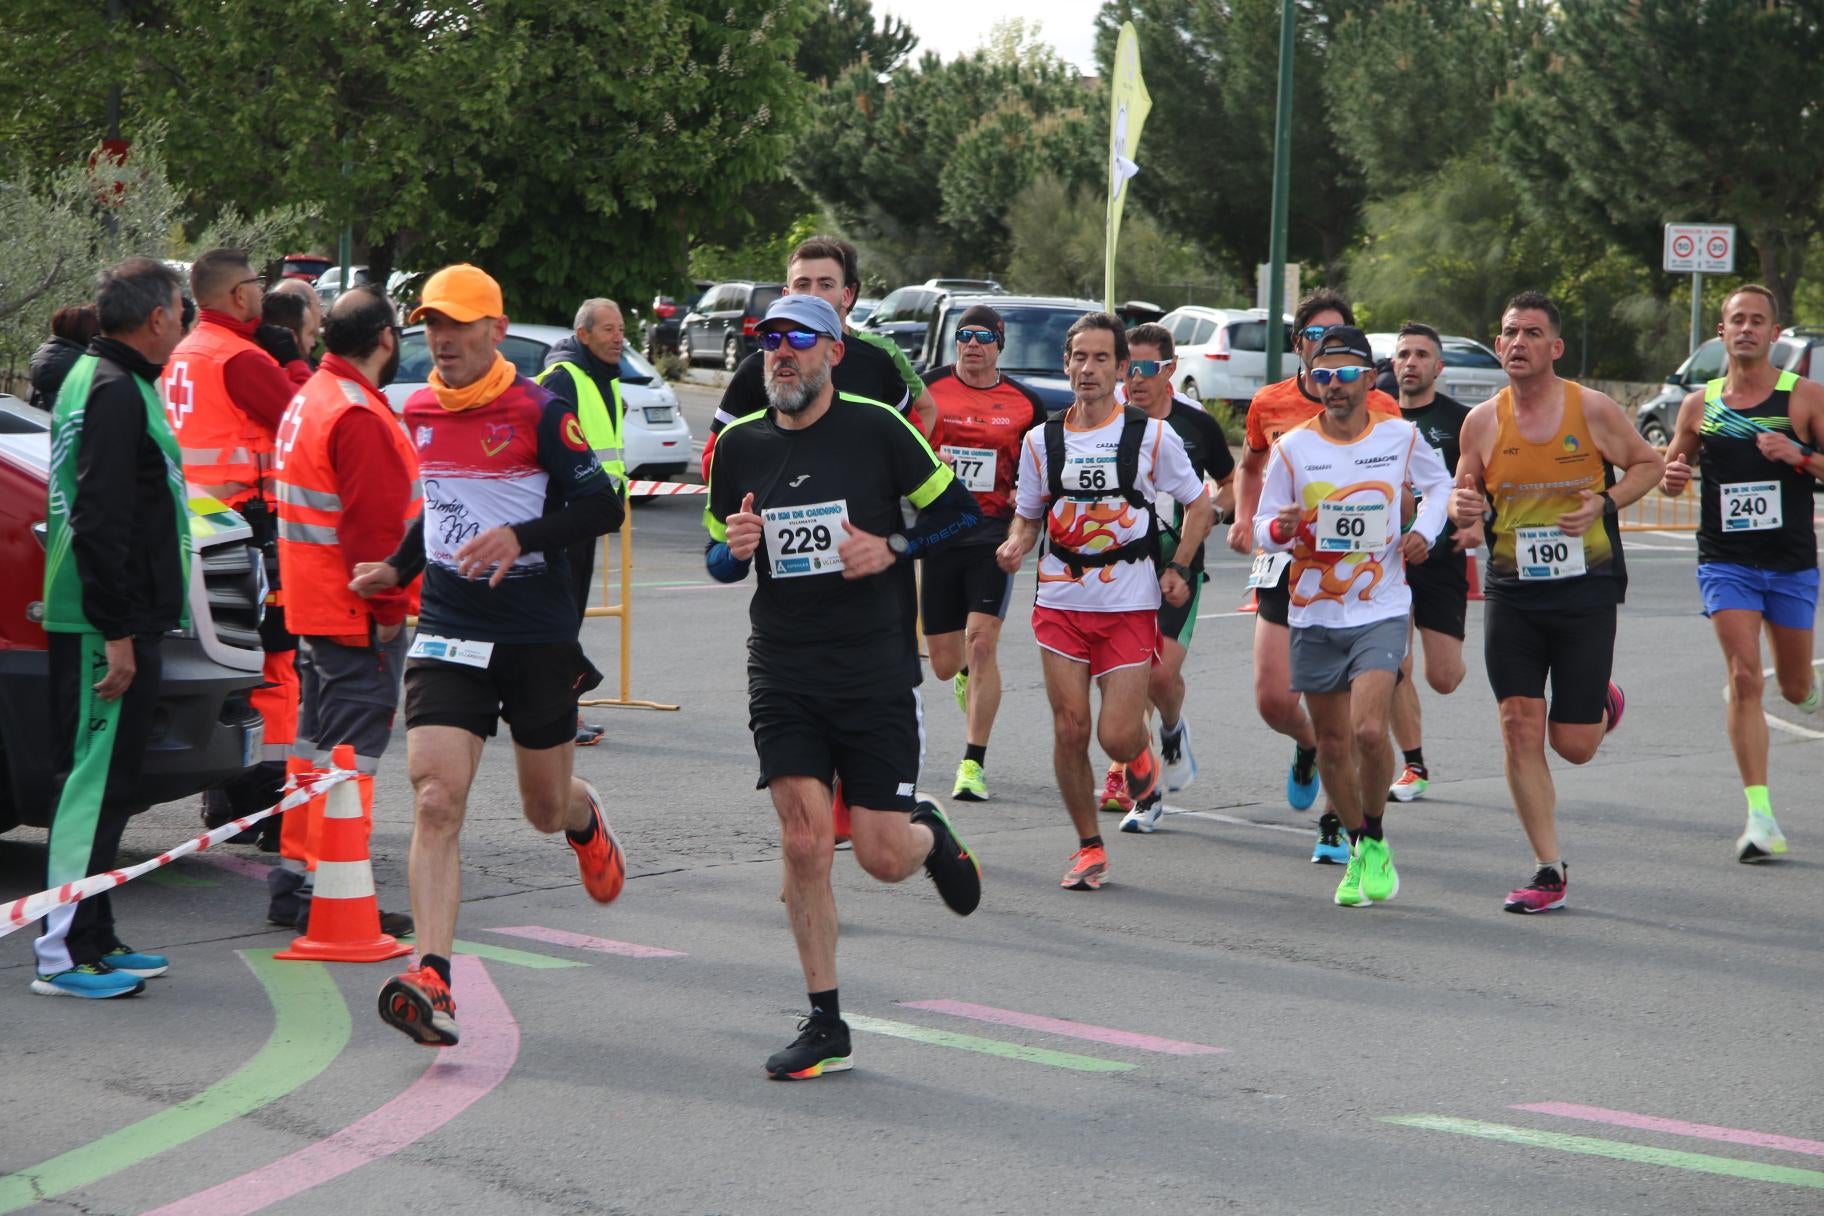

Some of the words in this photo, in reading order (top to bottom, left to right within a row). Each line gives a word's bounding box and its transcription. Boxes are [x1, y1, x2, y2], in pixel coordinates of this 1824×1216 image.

[991, 417, 1011, 425] 2020
[950, 459, 984, 478] 177
[1078, 469, 1107, 490] 56
[765, 512, 777, 522] 10
[777, 511, 791, 521] KM
[792, 510, 805, 519] DE
[1729, 496, 1768, 517] 240
[1335, 517, 1366, 537] 60
[778, 524, 832, 556] 229
[1527, 543, 1569, 564] 190
